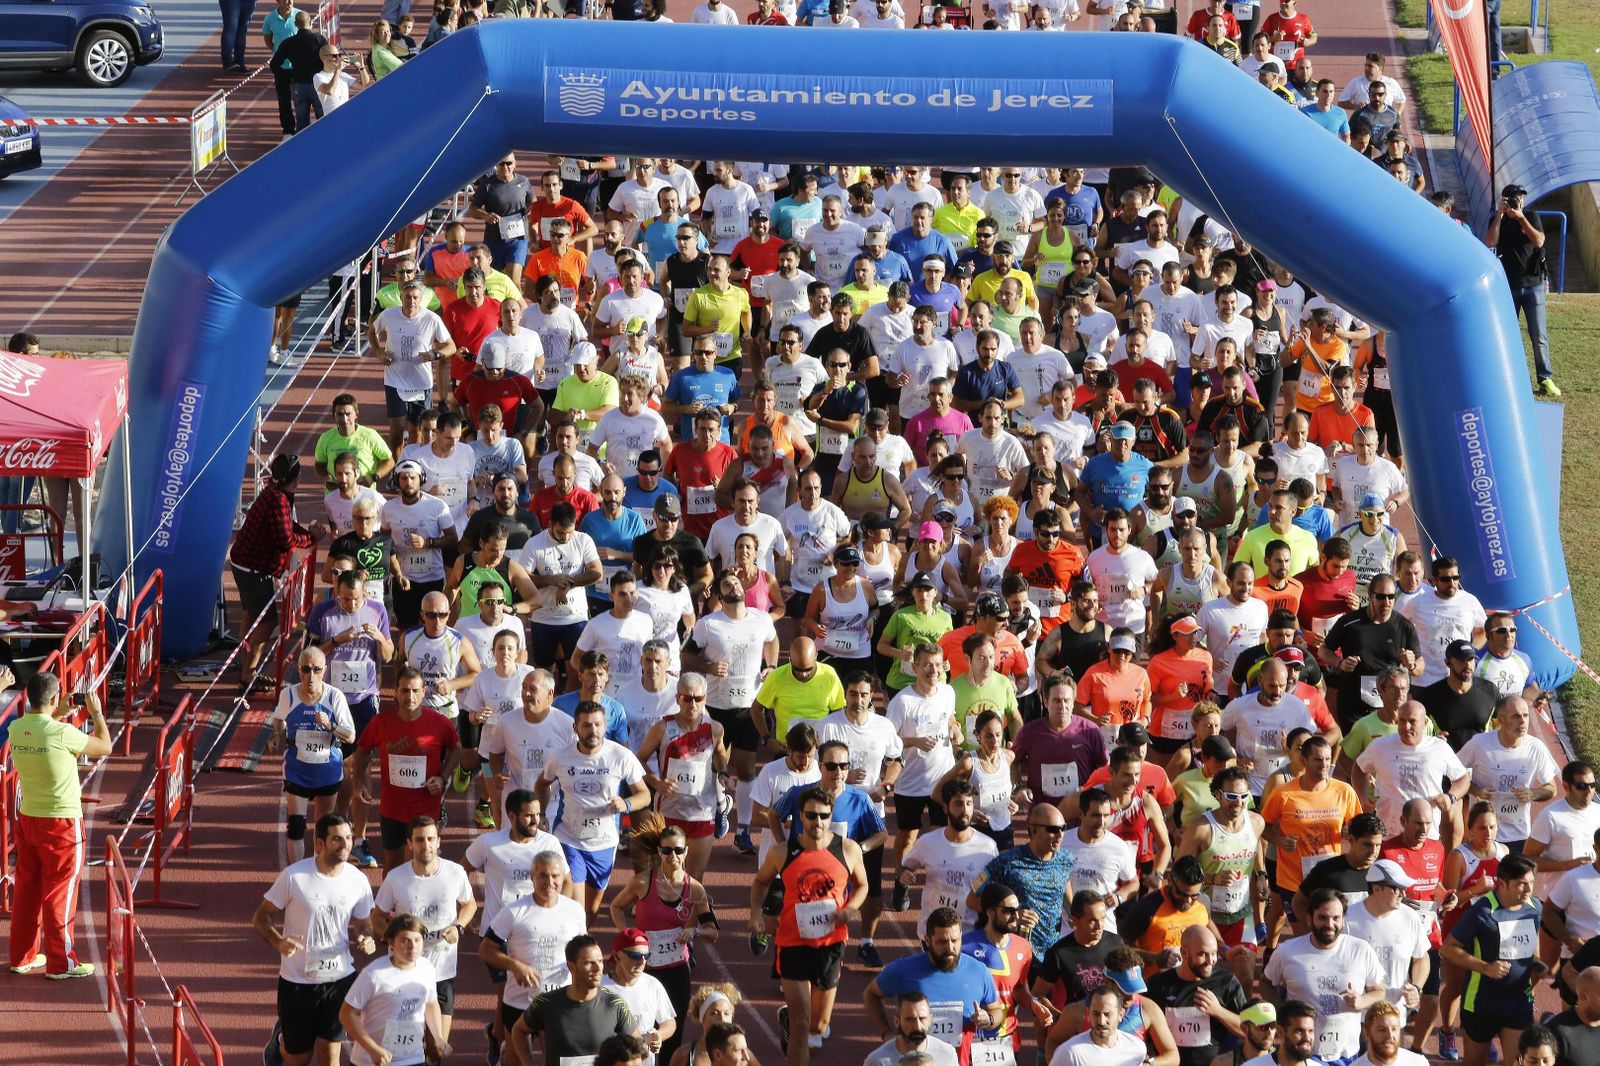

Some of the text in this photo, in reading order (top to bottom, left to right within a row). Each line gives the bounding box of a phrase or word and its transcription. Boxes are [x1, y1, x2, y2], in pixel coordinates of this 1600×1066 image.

[620, 80, 1095, 113] Ayuntamiento de Jerez
[620, 103, 757, 122] Deportes
[156, 385, 202, 548] deportes@aytojerez.es
[980, 488, 994, 496] 735
[1460, 412, 1508, 577] deportes@aytojerez.es
[695, 496, 710, 504] 638
[410, 557, 425, 565] 148
[807, 567, 823, 575] 507
[835, 640, 851, 649] 770
[341, 673, 359, 682] 242
[729, 689, 747, 697] 535
[1172, 722, 1188, 730] 561
[306, 743, 324, 752] 820
[399, 768, 418, 777] 606
[677, 773, 696, 783] 634
[1053, 776, 1071, 786] 133
[992, 792, 1007, 803] 149
[1501, 804, 1518, 813] 608
[582, 818, 601, 827] 453
[939, 896, 958, 909] 814
[810, 914, 829, 926] 483
[1512, 936, 1529, 945] 793
[658, 942, 677, 954] 233
[933, 1022, 953, 1034] 212
[1179, 1023, 1200, 1033] 670
[394, 1035, 414, 1045] 315
[1319, 1033, 1339, 1042] 671
[985, 1052, 1005, 1062] 214
